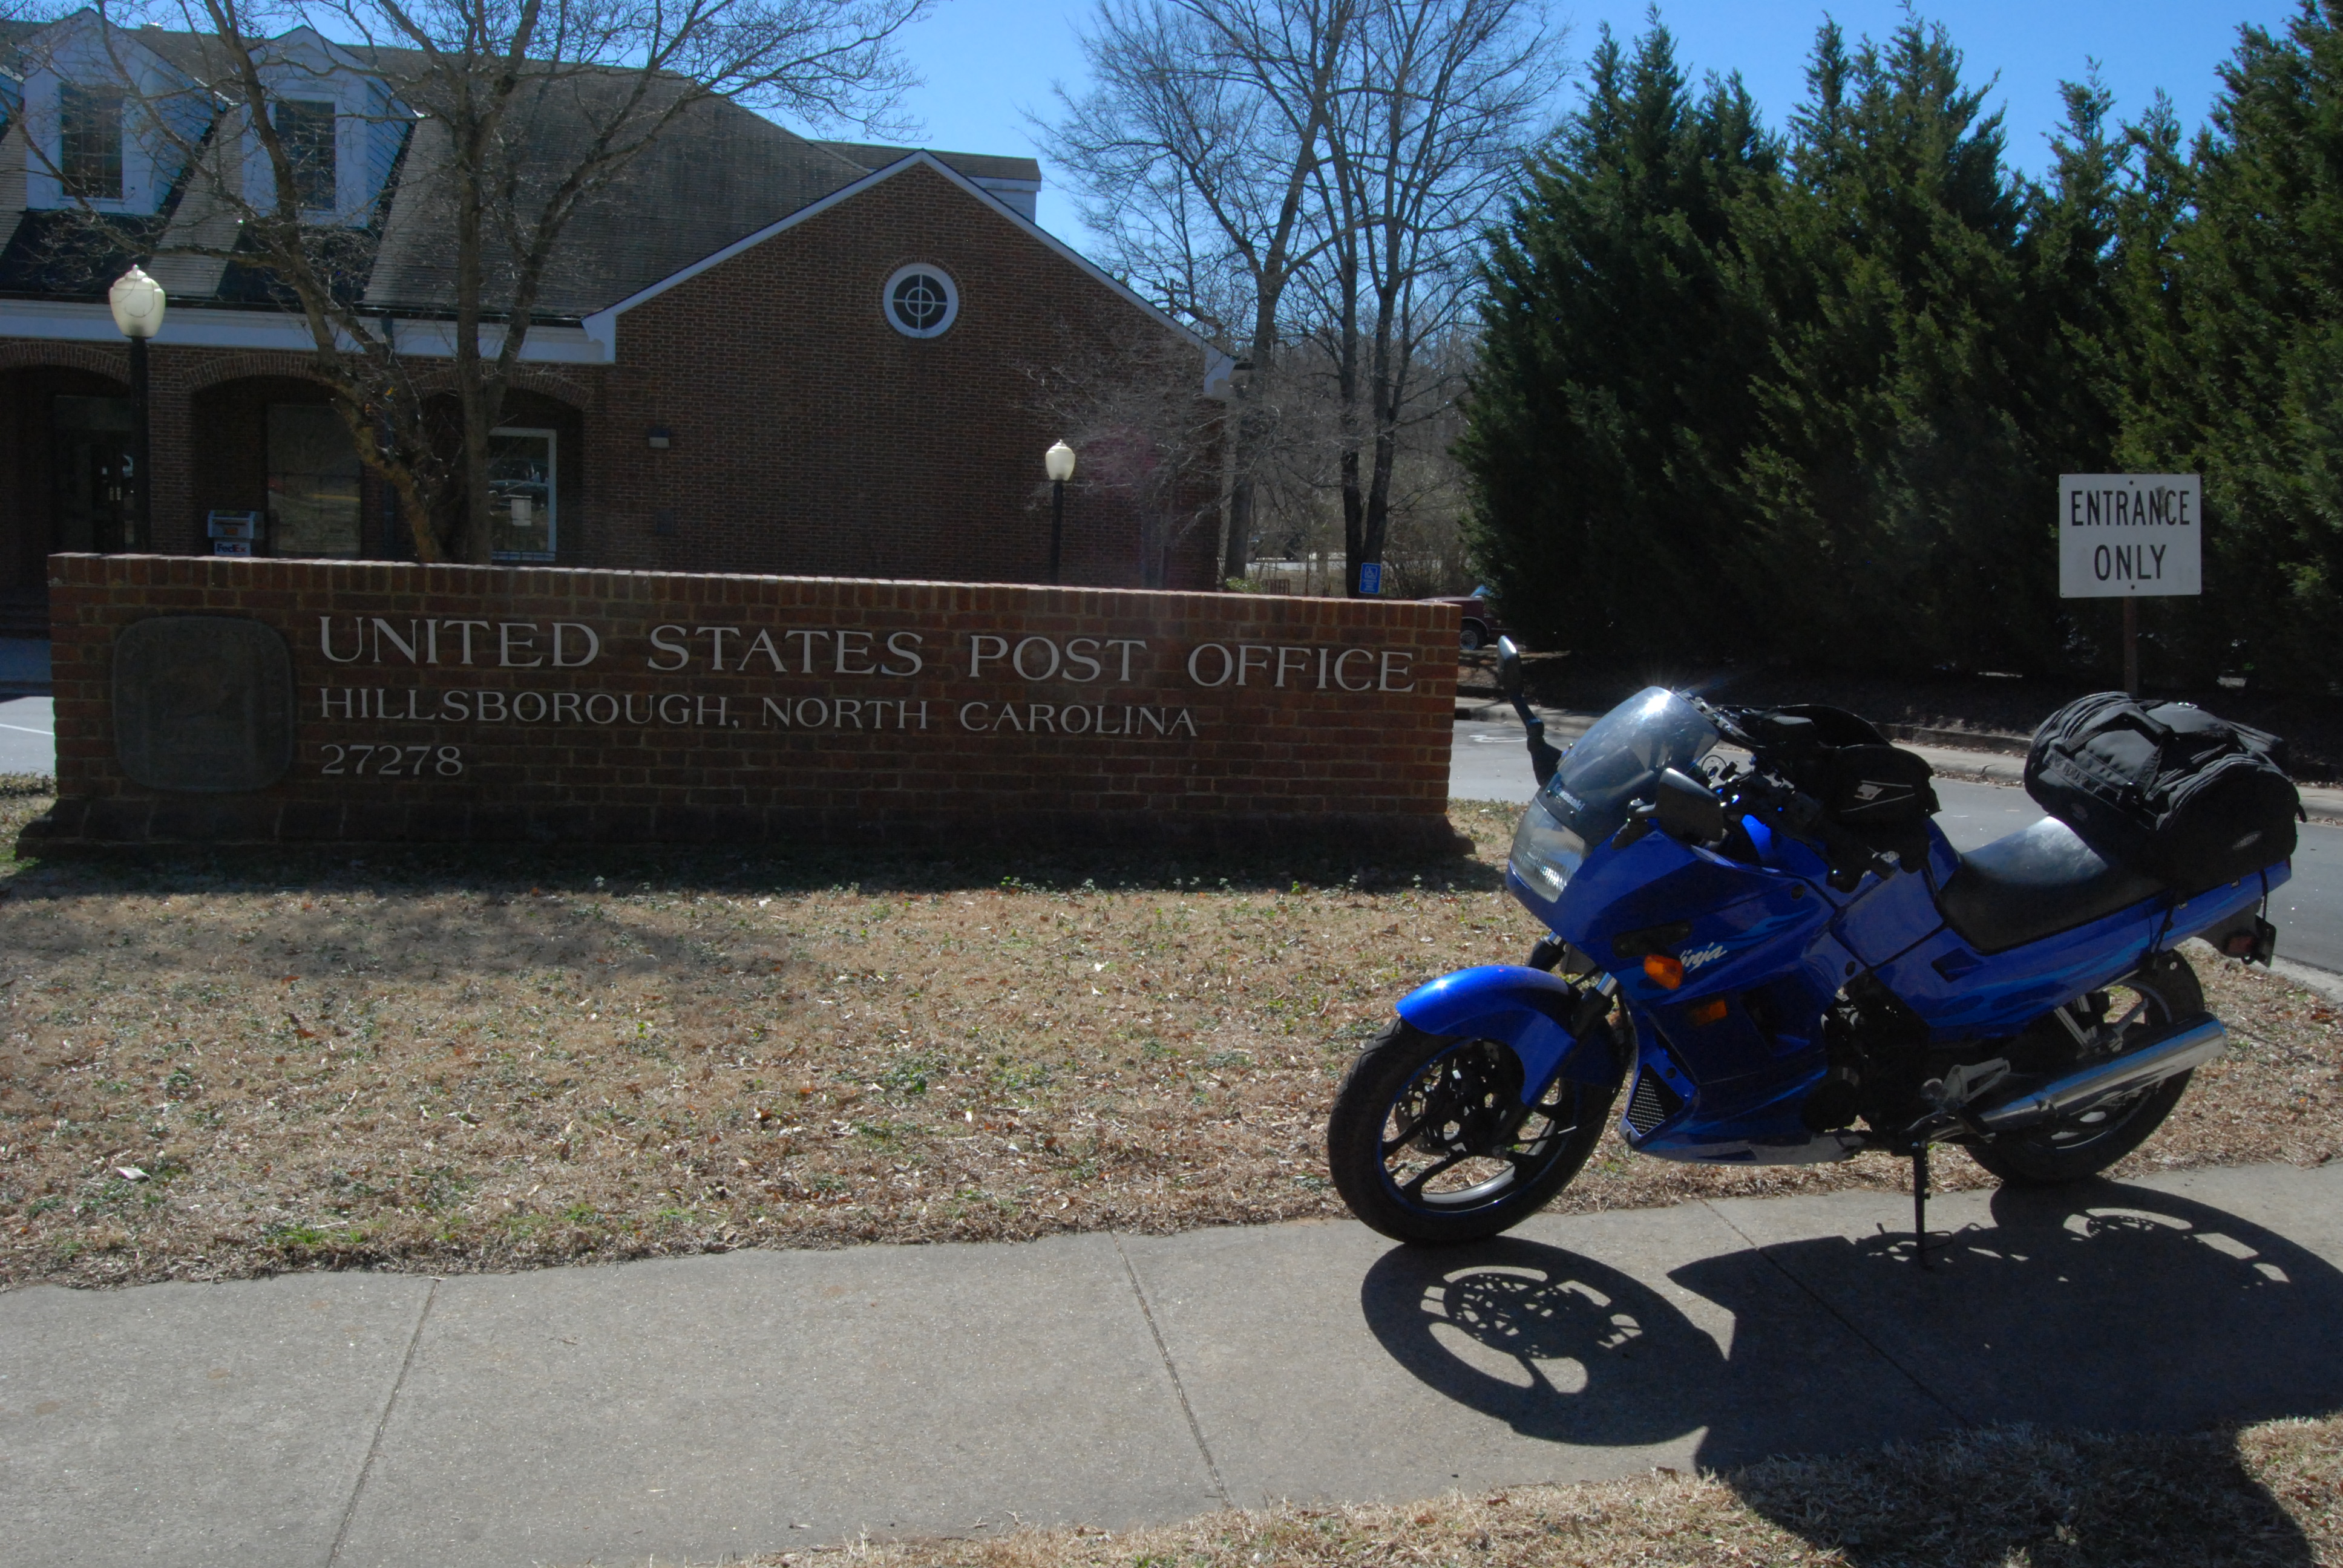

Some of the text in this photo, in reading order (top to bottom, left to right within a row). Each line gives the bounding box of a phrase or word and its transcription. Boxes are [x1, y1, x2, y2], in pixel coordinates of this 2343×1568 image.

[2071, 491, 2190, 526] ENTRANCE
[217, 543, 247, 553] FedEx
[2095, 544, 2166, 581] ONLY
[320, 616, 1415, 693] UNITED STATES POST OFFICE
[321, 688, 1198, 737] HILLSBOROUGH, NORTH CAROLINA
[321, 744, 463, 776] 27278
[1679, 941, 1728, 973] inja
